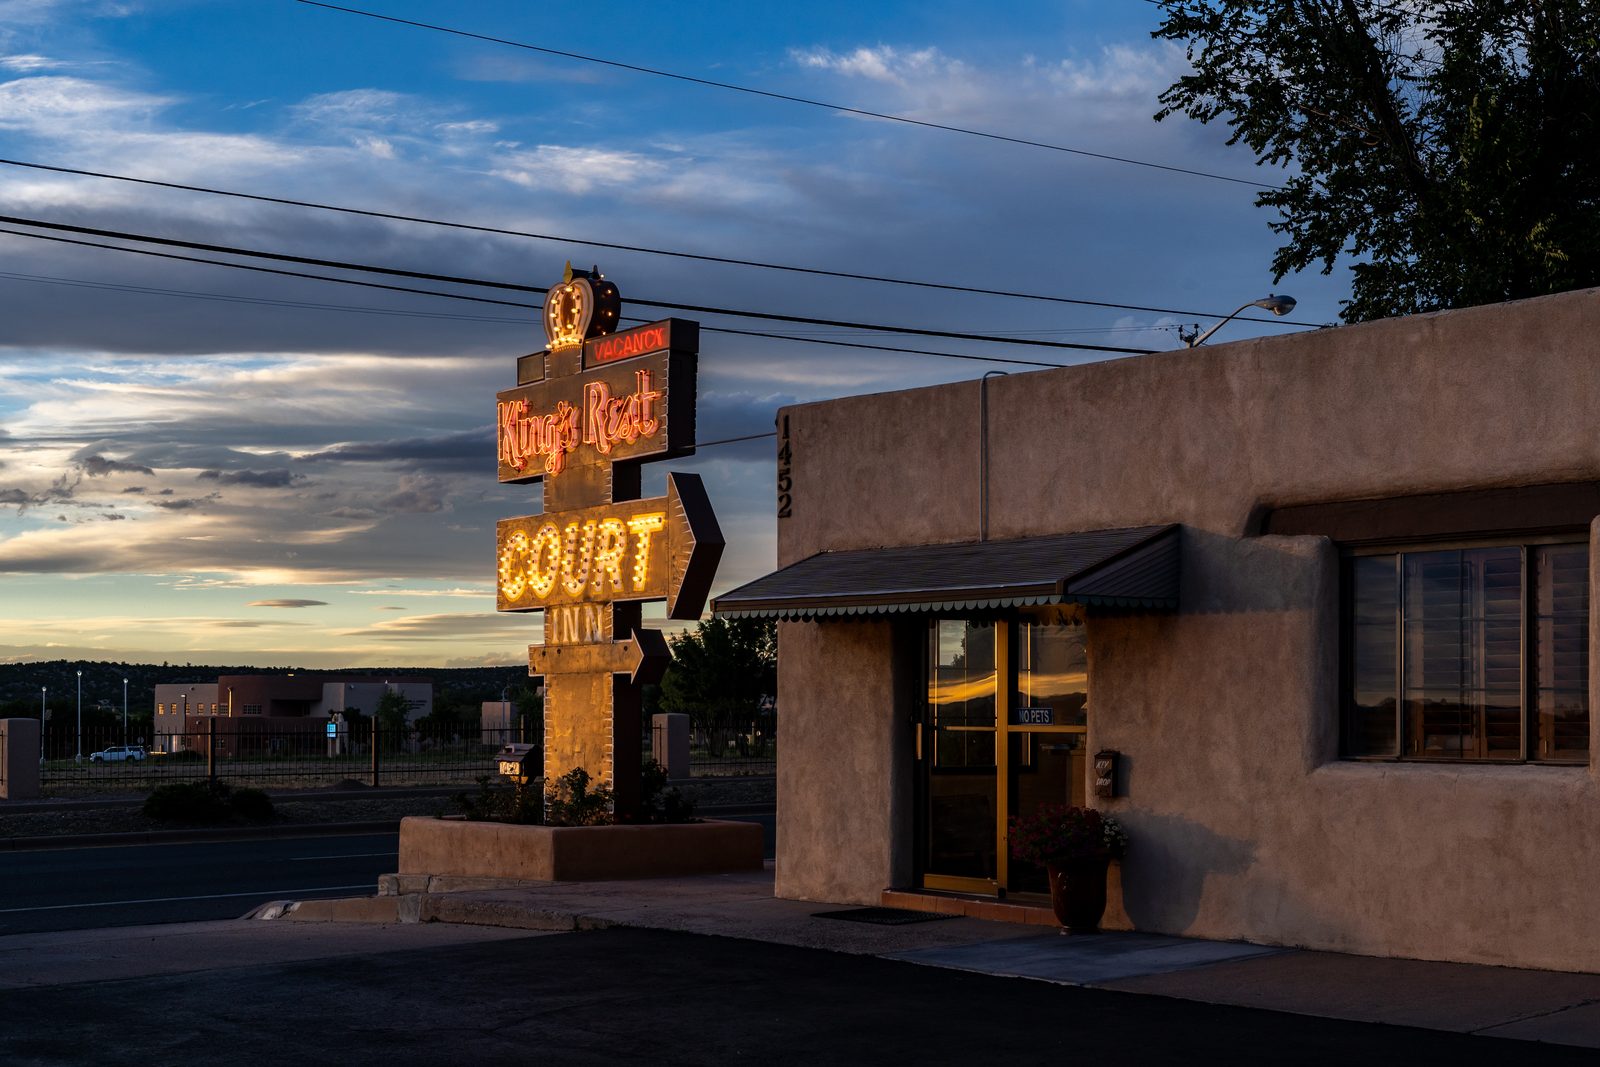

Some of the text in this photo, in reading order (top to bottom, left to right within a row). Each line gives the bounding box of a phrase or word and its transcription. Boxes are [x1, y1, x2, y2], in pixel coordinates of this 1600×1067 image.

[594, 328, 664, 360] VACANCY
[497, 369, 662, 474] King's Rest
[778, 414, 792, 519] 1452
[500, 511, 667, 602] COURT
[551, 605, 604, 643] INN
[1019, 710, 1050, 723] NO PETS
